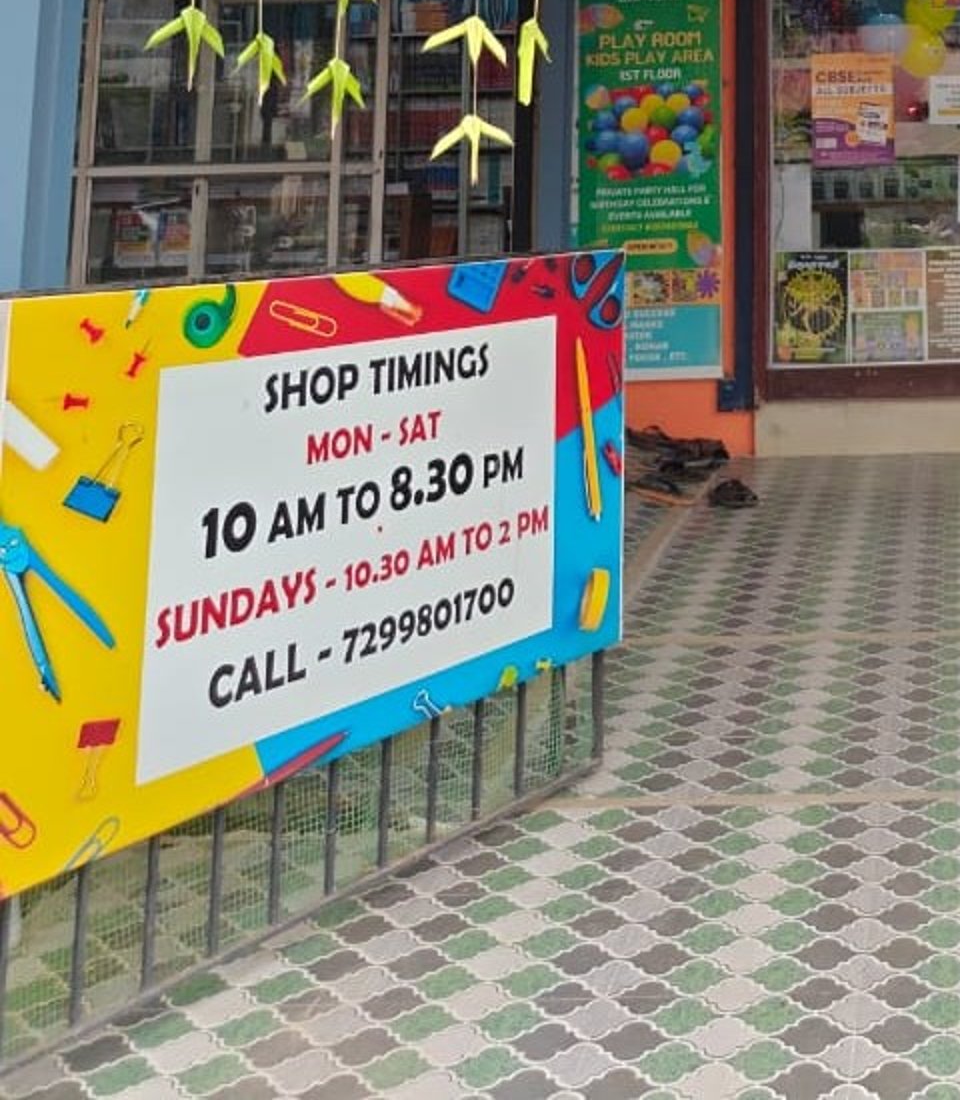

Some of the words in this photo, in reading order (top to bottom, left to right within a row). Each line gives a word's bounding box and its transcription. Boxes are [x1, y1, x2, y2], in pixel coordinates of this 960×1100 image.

[586, 52, 621, 67] KIDS
[625, 50, 668, 65] PLAY
[671, 48, 714, 63] AREA
[599, 32, 646, 49] PLAY
[651, 31, 701, 47] ROOM
[643, 67, 682, 80] FLOOR
[816, 69, 856, 84] CBSE
[264, 363, 359, 413] SHOP
[369, 343, 490, 396] TIMINGS
[307, 424, 373, 464] MON
[398, 412, 442, 446] SAT
[202, 502, 256, 559] 10
[268, 493, 325, 543] AM
[337, 482, 380, 525] TO
[389, 453, 473, 510] 8.30
[484, 448, 524, 488] PM
[155, 567, 316, 649] SUNDAYS
[345, 554, 410, 590] 10.30
[417, 536, 455, 571] AM
[463, 522, 492, 556] TO
[499, 520, 512, 545] 2
[517, 506, 549, 543] PM
[209, 643, 307, 708] CALL
[342, 577, 515, 664] 7299801700
